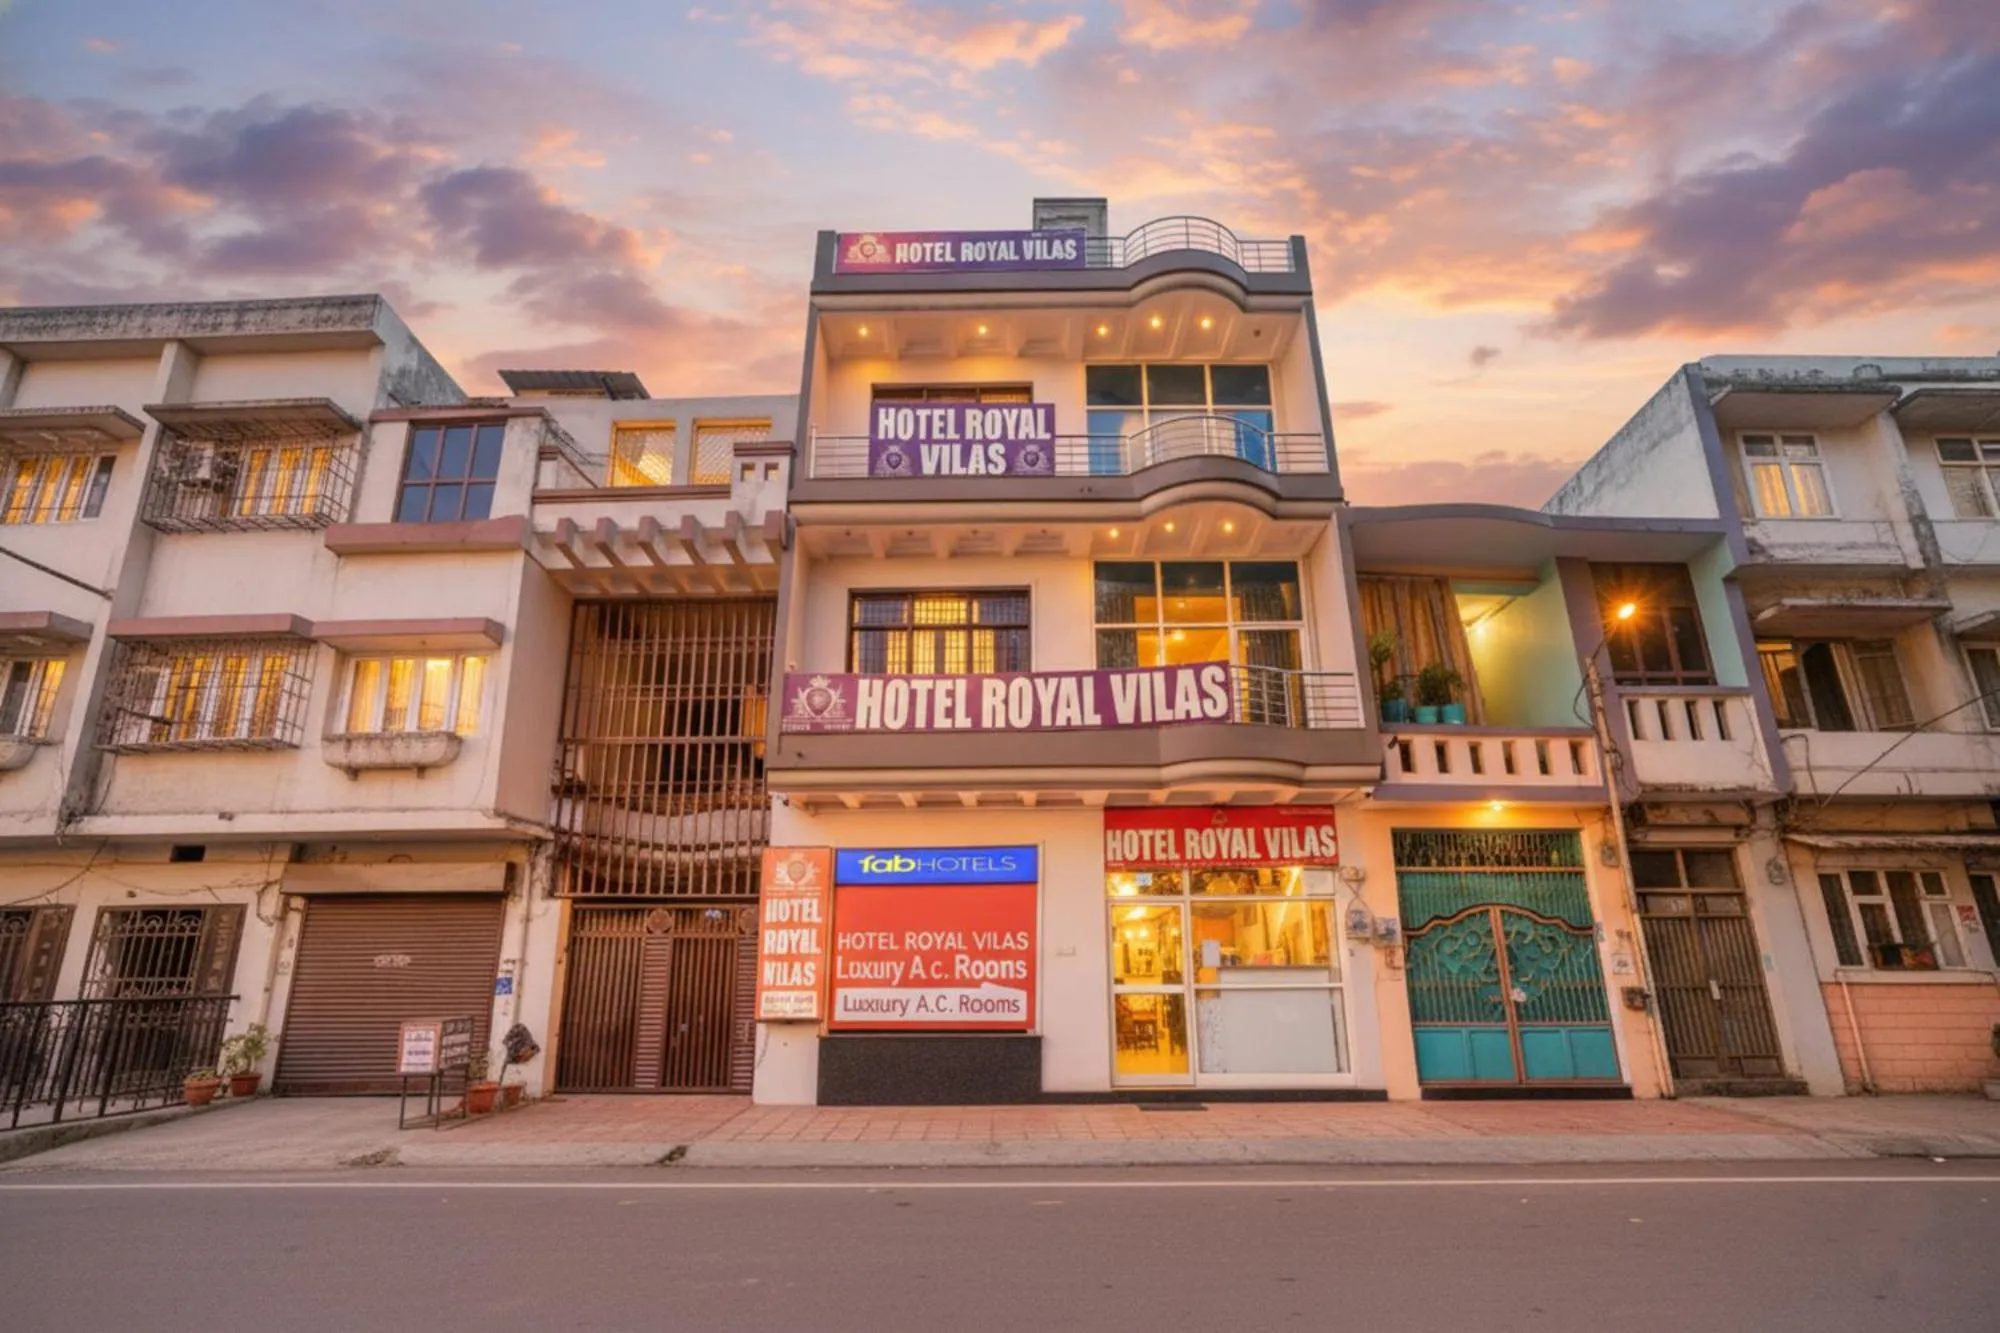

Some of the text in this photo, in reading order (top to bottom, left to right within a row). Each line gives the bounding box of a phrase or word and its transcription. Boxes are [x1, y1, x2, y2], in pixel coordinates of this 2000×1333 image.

[895, 239, 1077, 264] HOTEL ROYAL VILAS
[877, 407, 1052, 441] HOTEL ROYAL
[920, 443, 1007, 476] VILAS
[855, 665, 1230, 730] HOTEL ROYAL VILAS
[1106, 825, 1336, 861] HOTEL ROYAL VILAS
[764, 898, 822, 923] HOTEL
[763, 928, 822, 955] ROYAL
[837, 931, 1029, 950] HOTEL ROYAL VILAS
[954, 953, 1028, 980] Rooms
[916, 995, 953, 1013] A.C.
[959, 994, 1021, 1013] Rooms
